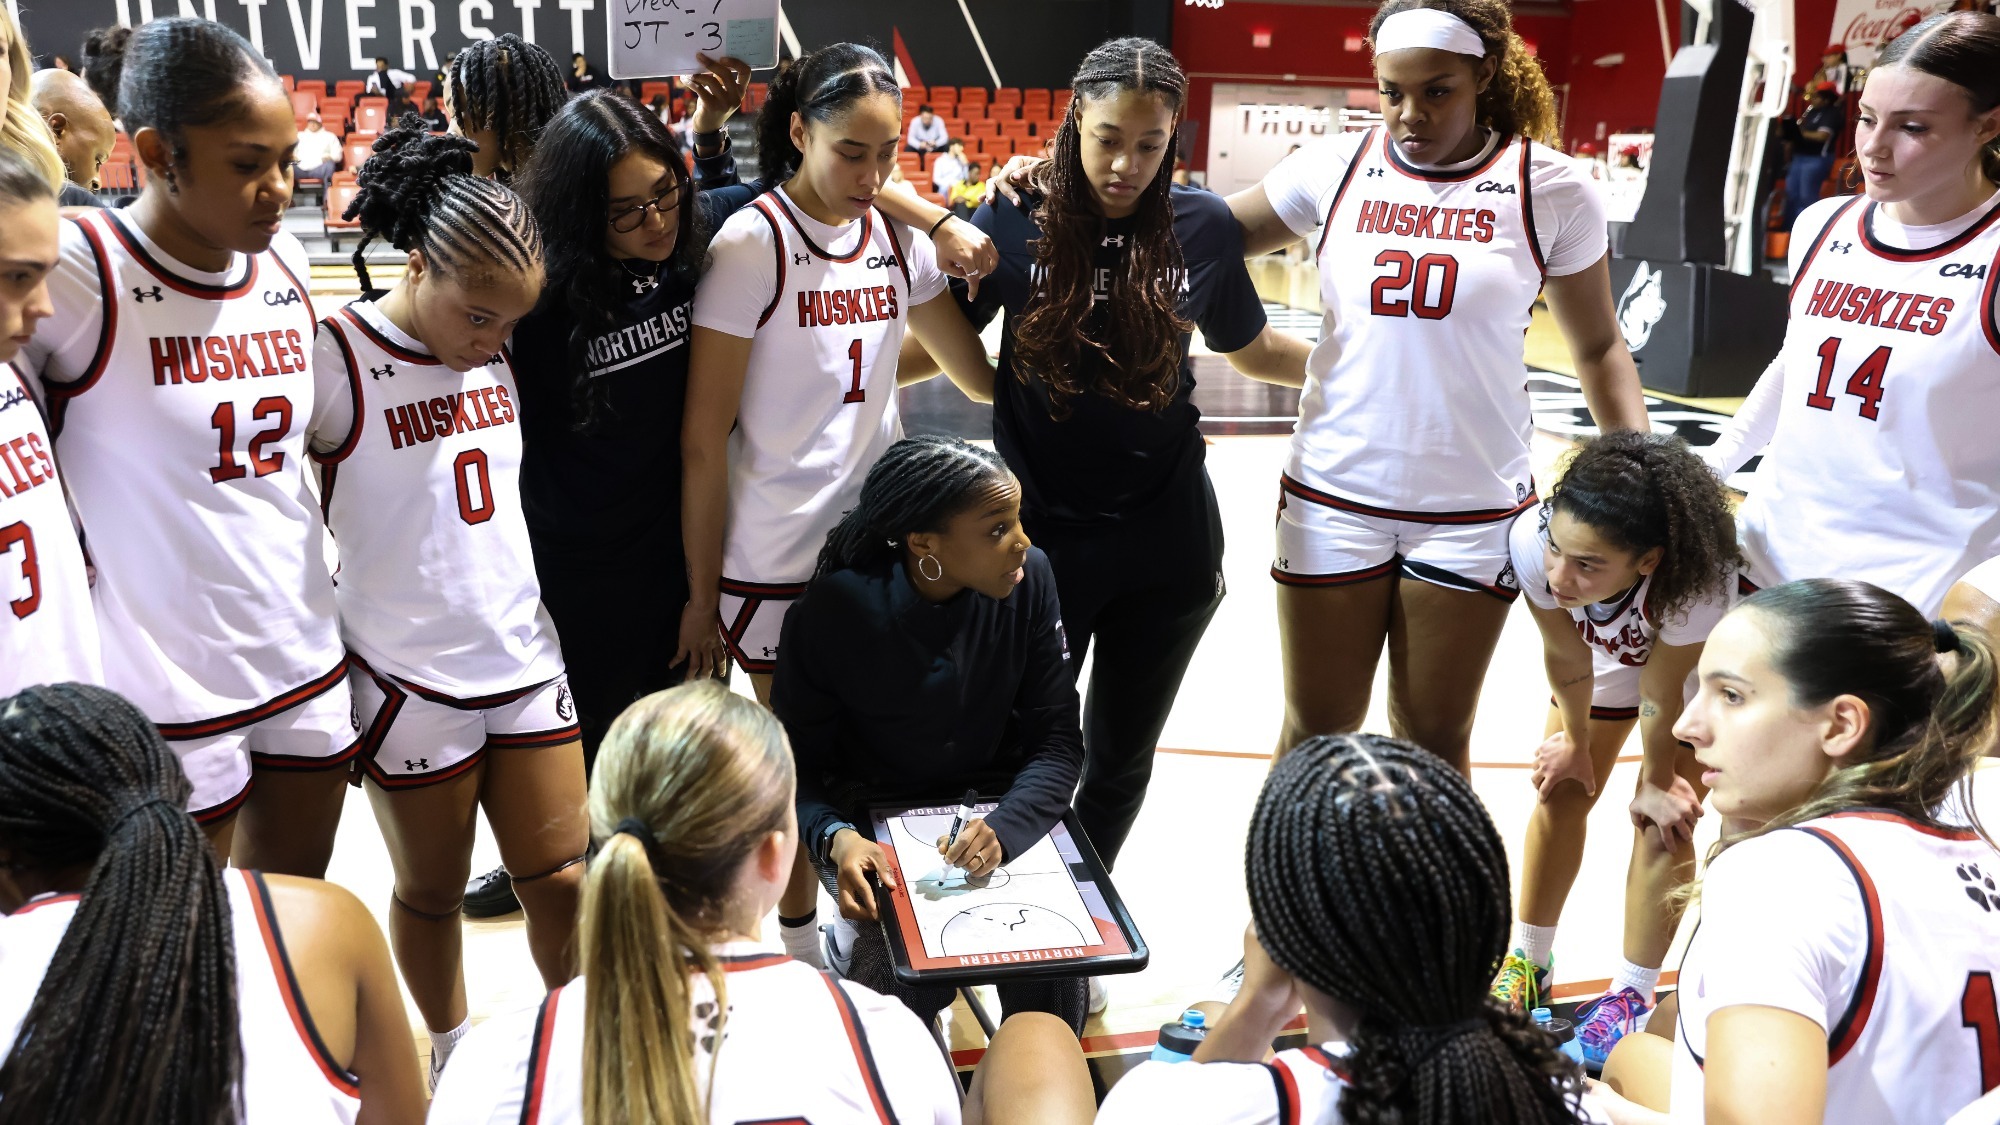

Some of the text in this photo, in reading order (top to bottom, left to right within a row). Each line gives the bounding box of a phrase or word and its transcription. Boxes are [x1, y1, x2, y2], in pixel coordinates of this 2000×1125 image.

[624, 20, 670, 50] JT
[1475, 180, 1517, 195] CAA
[1356, 199, 1497, 244] HUSKIES
[866, 255, 899, 270] CAA
[1370, 248, 1460, 321] 20
[1939, 262, 1987, 280] CAA
[263, 287, 303, 307] CAA
[797, 284, 900, 328] HUSKIES
[1804, 278, 1956, 337] HUSKIES
[149, 329, 307, 386] HUSKIES
[842, 338, 866, 405] 1
[1806, 336, 1894, 422] 14
[208, 395, 294, 485] 12
[384, 384, 516, 451] HUSKIES
[452, 447, 496, 527] 0
[0, 519, 43, 621] 3
[959, 947, 1085, 967] NORTHEASTERN
